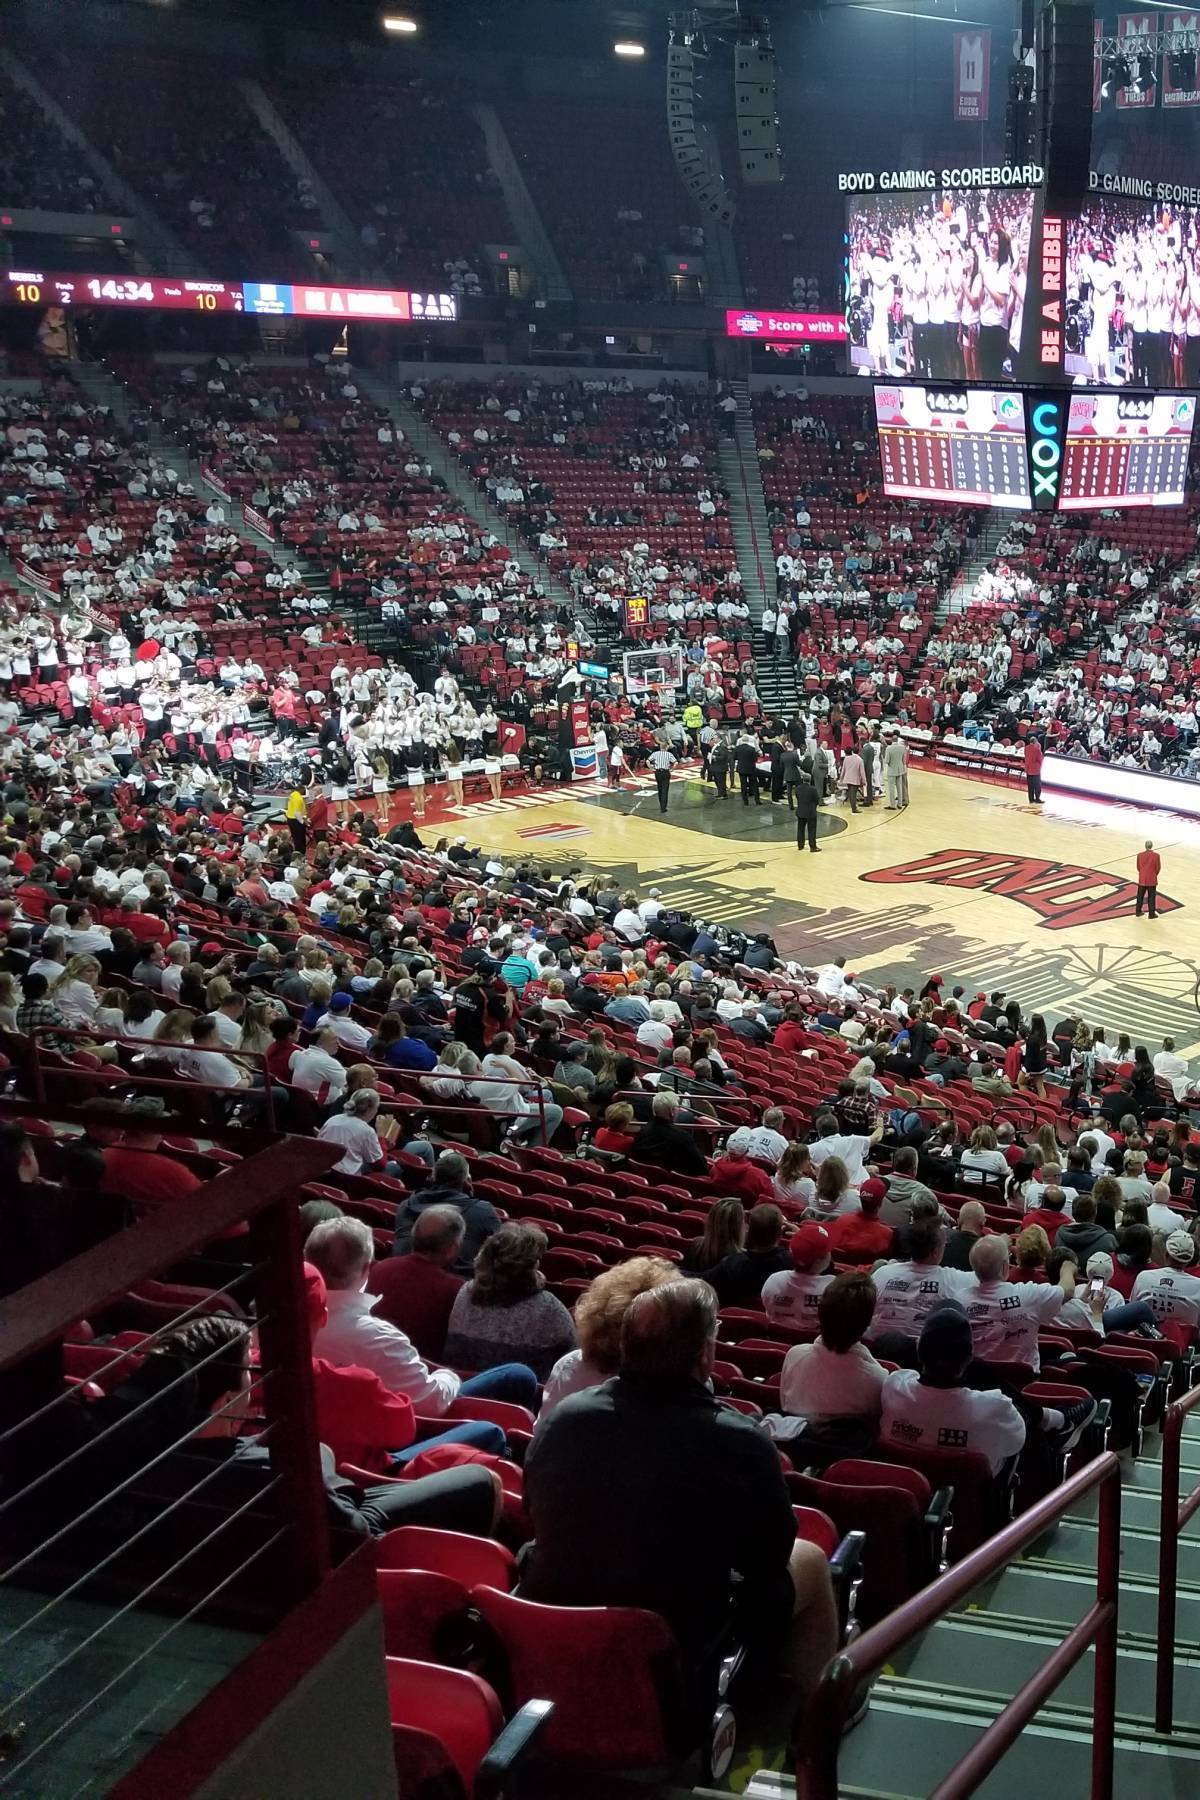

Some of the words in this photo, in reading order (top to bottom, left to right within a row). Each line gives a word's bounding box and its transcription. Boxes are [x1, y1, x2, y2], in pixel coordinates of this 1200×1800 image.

[966, 61, 976, 80] 11
[838, 173, 874, 190] BOYD
[880, 170, 936, 189] GAMING
[942, 165, 1044, 186] SCOREBOARD
[1103, 174, 1152, 197] GAMING
[9, 272, 44, 282] REBELS
[16, 284, 40, 302] 10
[87, 279, 154, 302] 14:34
[184, 282, 225, 293] BRONCOS
[61, 292, 71, 303] 2
[196, 294, 216, 310] 10
[234, 301, 242, 311] 4
[1042, 300, 1060, 322] A
[768, 318, 804, 332] Score
[808, 320, 834, 333] with
[1042, 330, 1060, 362] BE
[927, 392, 968, 411] 14:34
[1119, 400, 1153, 417] 14:34
[1032, 404, 1060, 496] COX
[630, 608, 644, 622] 30
[858, 848, 1186, 930] UNLV
[1182, 1176, 1195, 1196] 5
